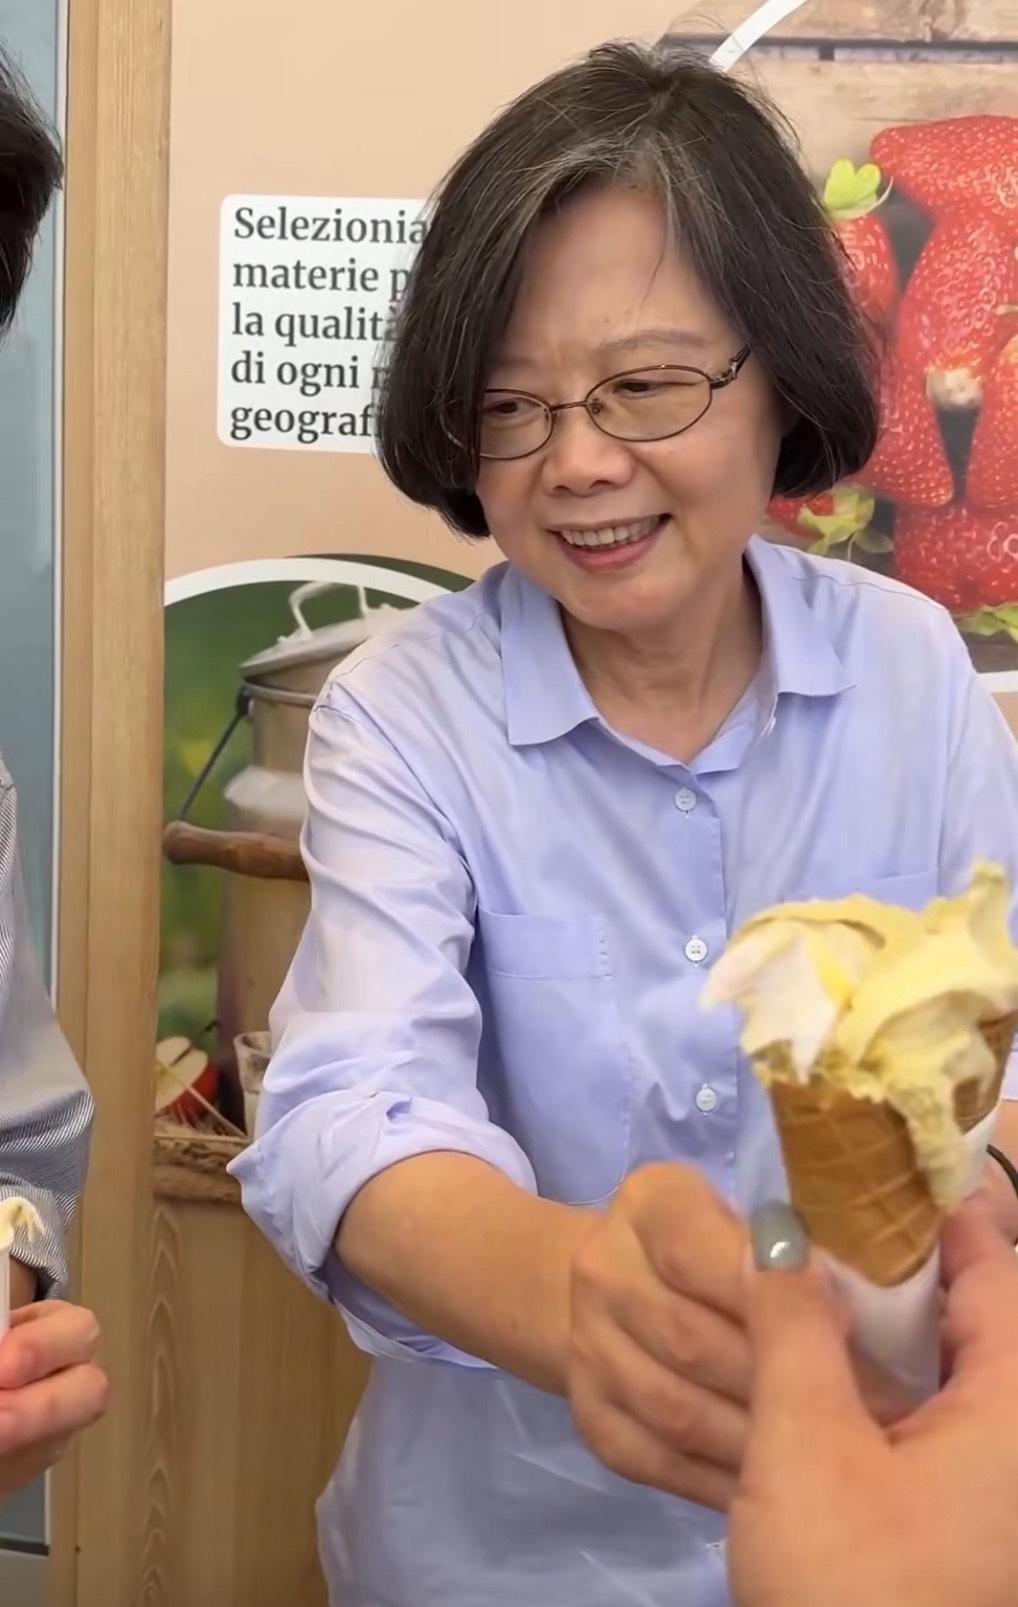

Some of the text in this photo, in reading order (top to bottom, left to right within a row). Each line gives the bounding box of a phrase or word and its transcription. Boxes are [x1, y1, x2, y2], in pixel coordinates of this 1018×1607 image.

[233, 258, 379, 292] materie
[232, 303, 264, 336] la
[231, 350, 266, 385] di
[277, 355, 360, 397] ogni
